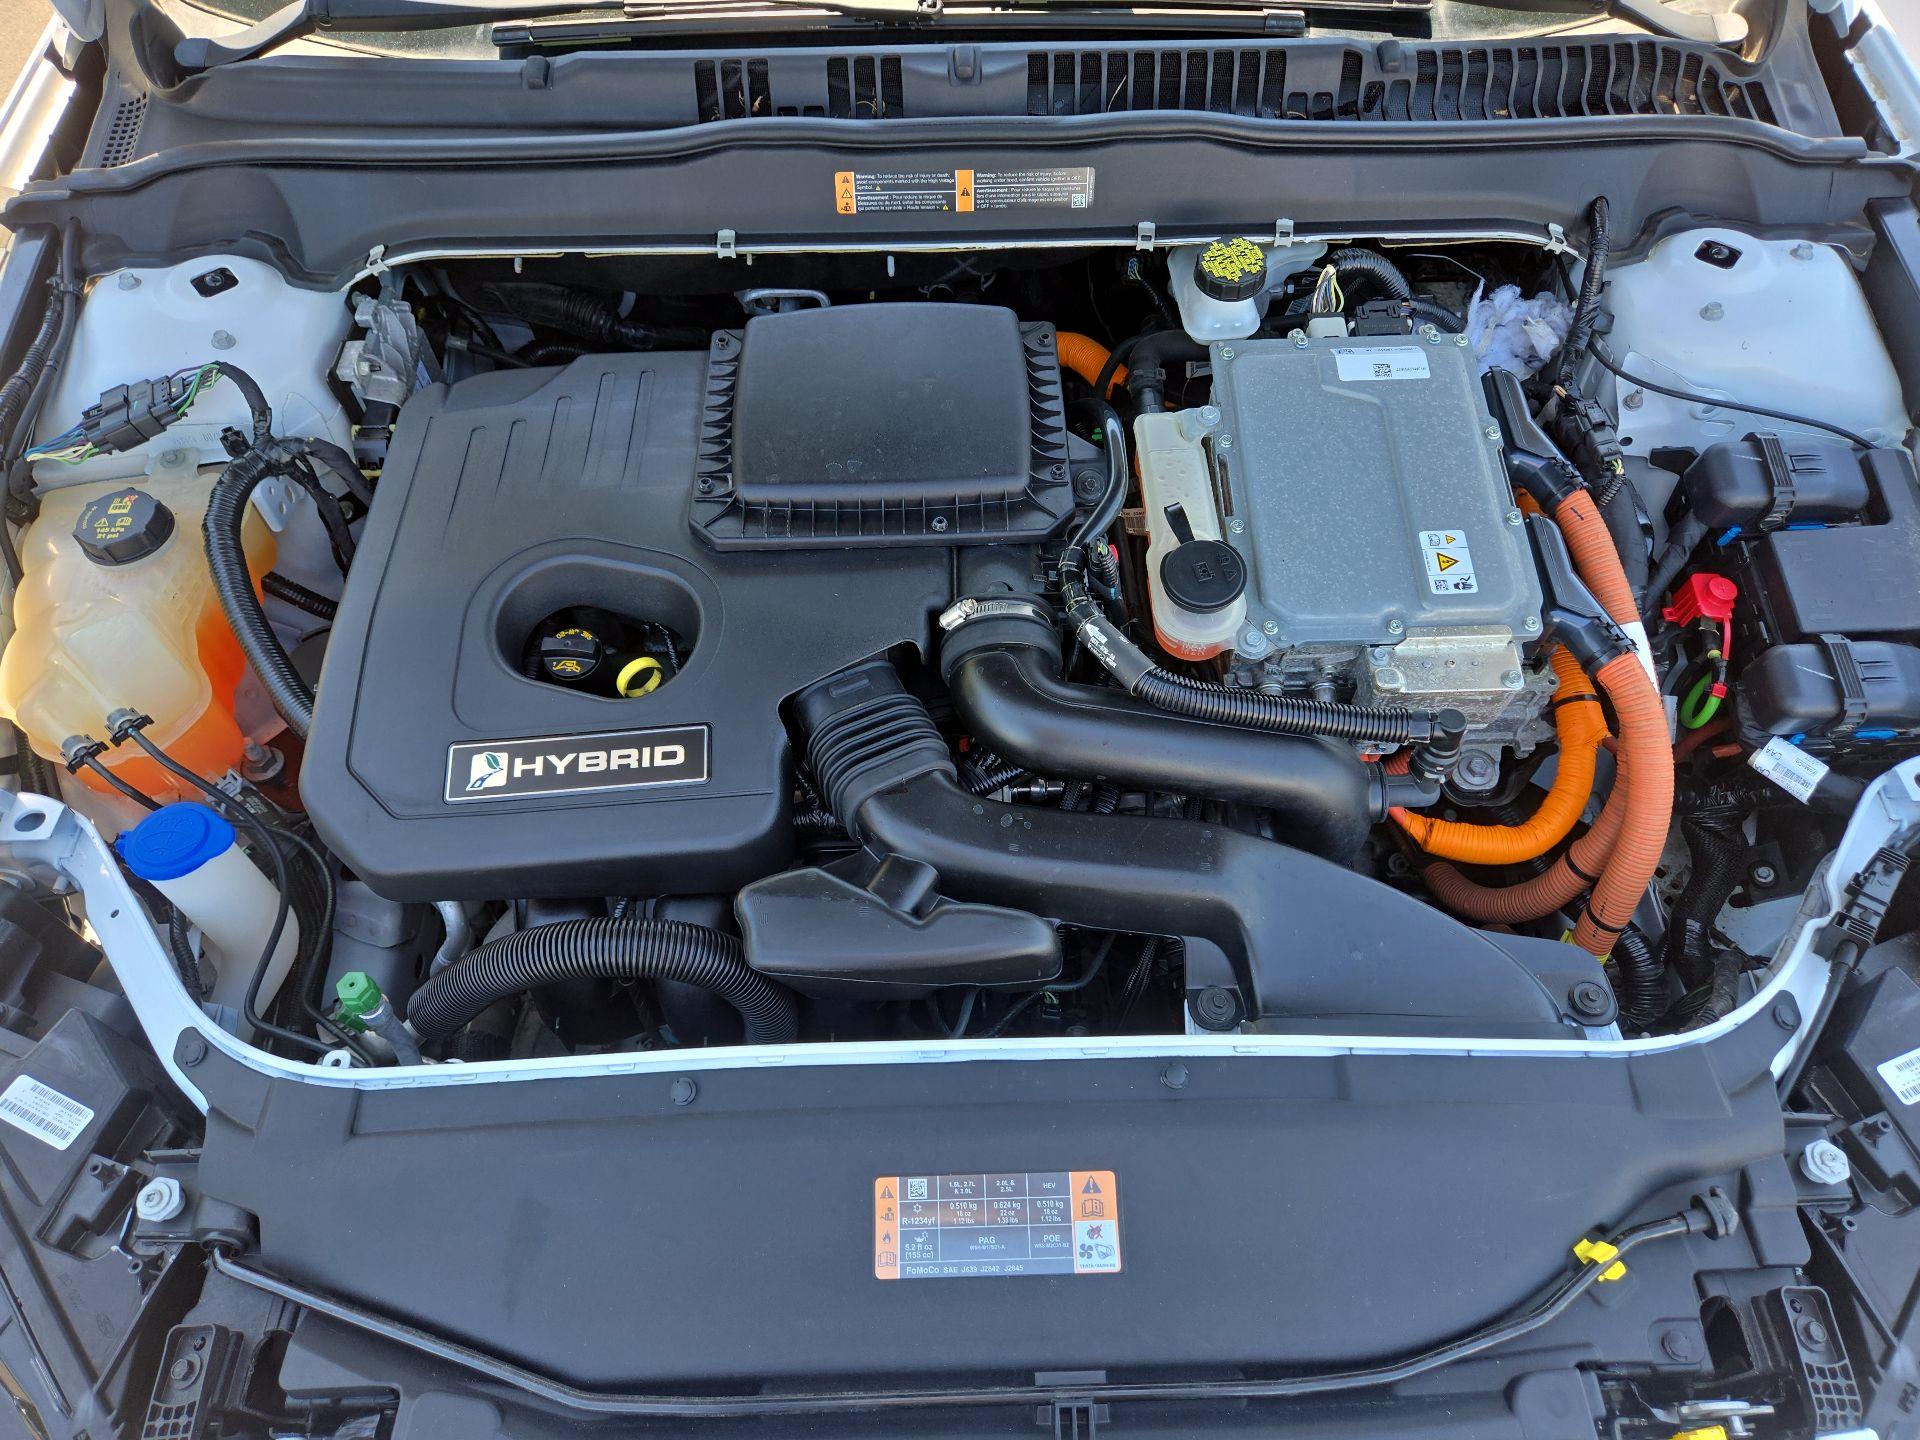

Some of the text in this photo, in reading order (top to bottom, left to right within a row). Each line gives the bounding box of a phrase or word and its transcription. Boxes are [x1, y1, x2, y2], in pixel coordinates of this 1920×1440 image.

[580, 630, 592, 640] SAE
[1766, 746, 1783, 761] CAA
[513, 744, 685, 778] HYBRID
[950, 1201, 977, 1210] 0.510 kg
[993, 1201, 1021, 1210] 0.624 kg
[1037, 1200, 1064, 1209] 0.510 kg
[902, 1216, 936, 1225] R-1234yf
[979, 1236, 996, 1244] PAG
[905, 1250, 934, 1260] (155 cc)
[906, 1266, 940, 1275] FoMoCo
[944, 1266, 958, 1274] SAE
[962, 1265, 977, 1273] J639
[1004, 1264, 1024, 1272] J2845
